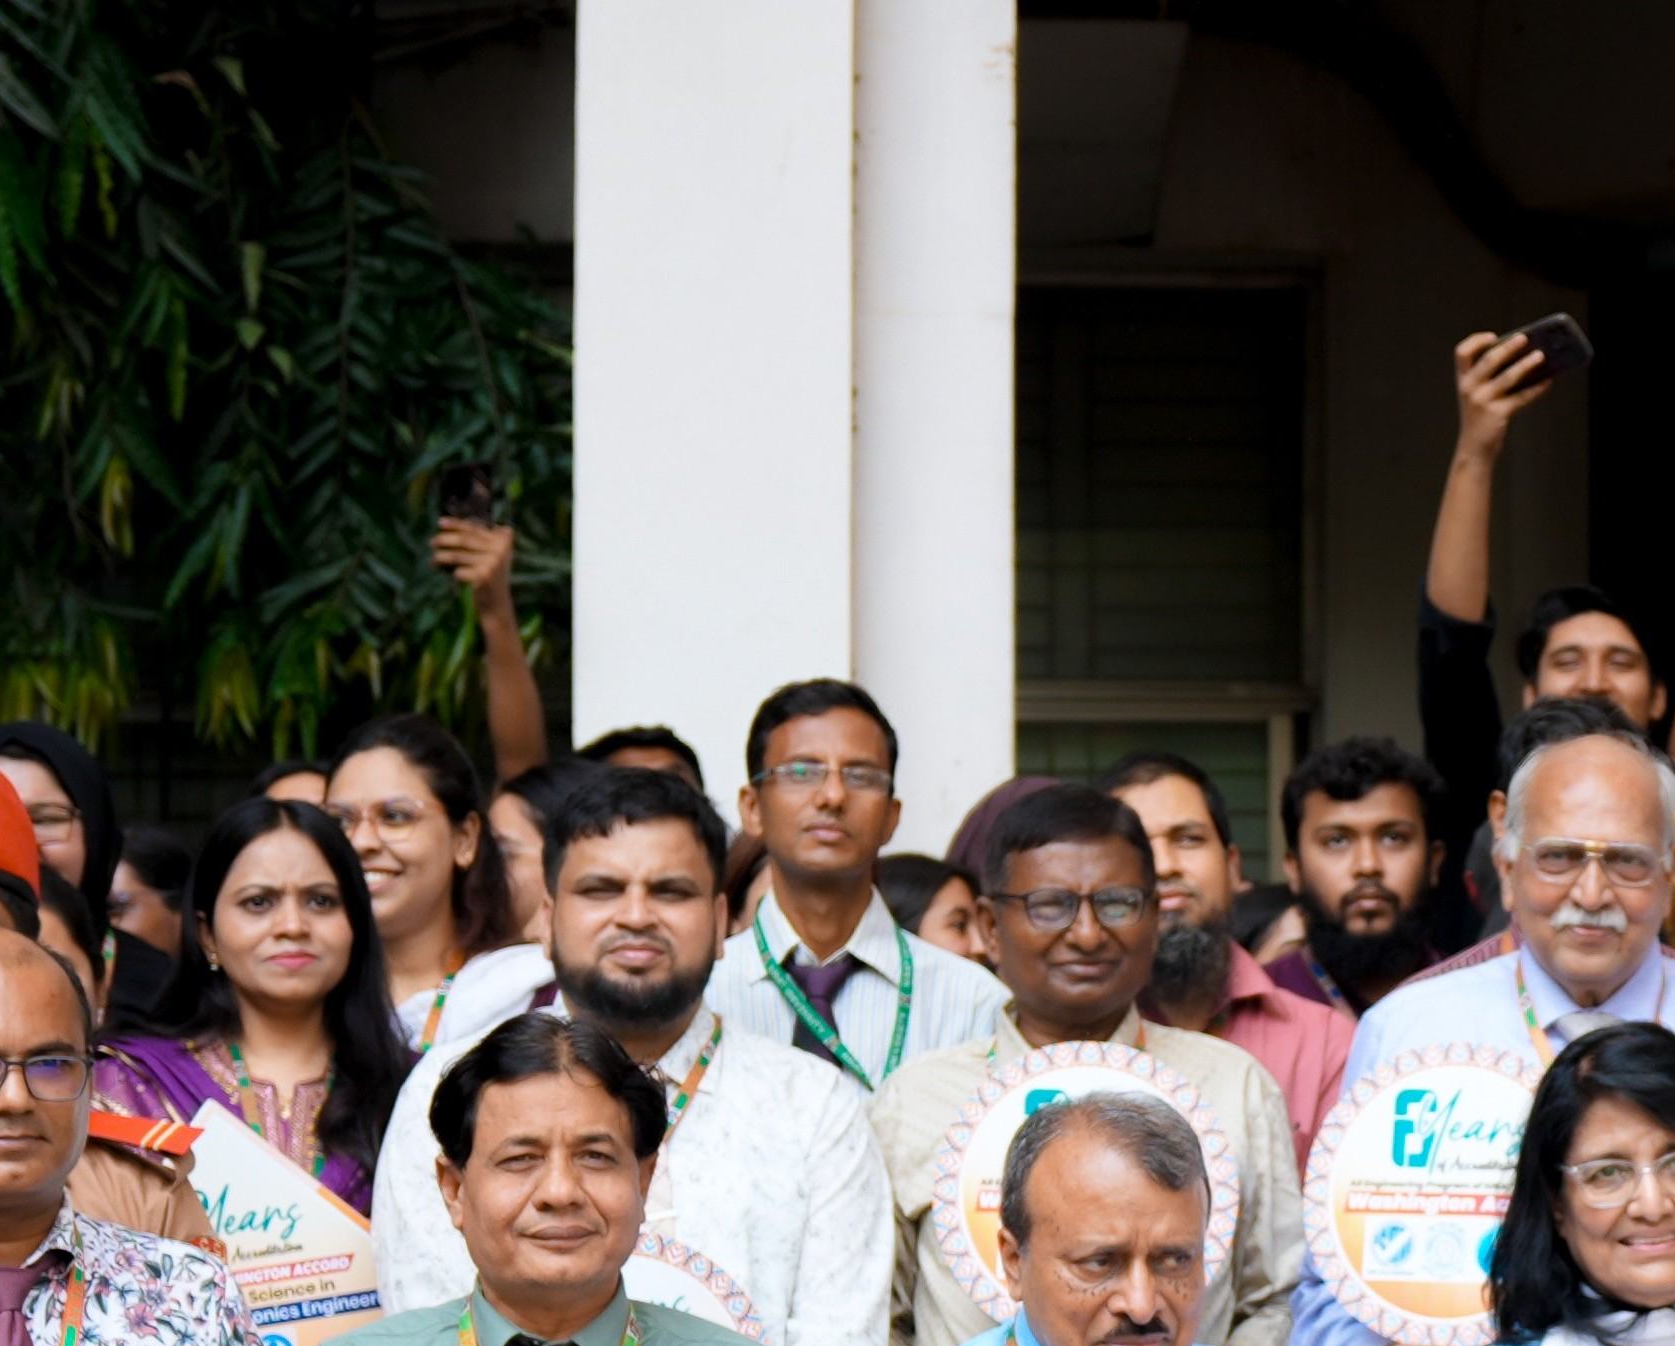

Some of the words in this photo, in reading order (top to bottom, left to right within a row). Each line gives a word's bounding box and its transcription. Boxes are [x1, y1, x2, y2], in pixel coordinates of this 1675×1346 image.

[294, 1255, 350, 1277] ACCORD
[248, 1282, 316, 1302] Science
[320, 1278, 336, 1292] in
